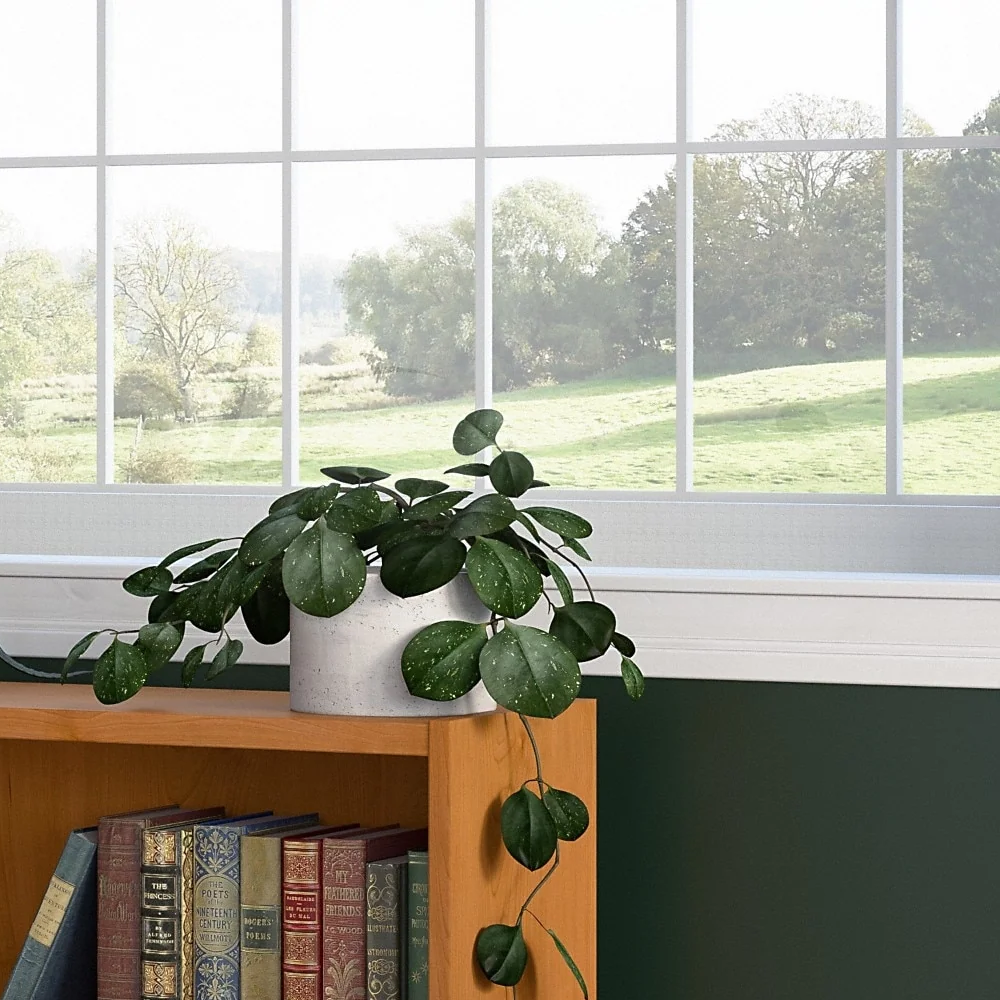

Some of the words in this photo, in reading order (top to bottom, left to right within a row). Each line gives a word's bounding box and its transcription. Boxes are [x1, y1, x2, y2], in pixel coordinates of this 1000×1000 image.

[201, 889, 229, 899] POETS
[196, 907, 238, 918] NINETEENTH
[200, 919, 232, 929] CENTURY
